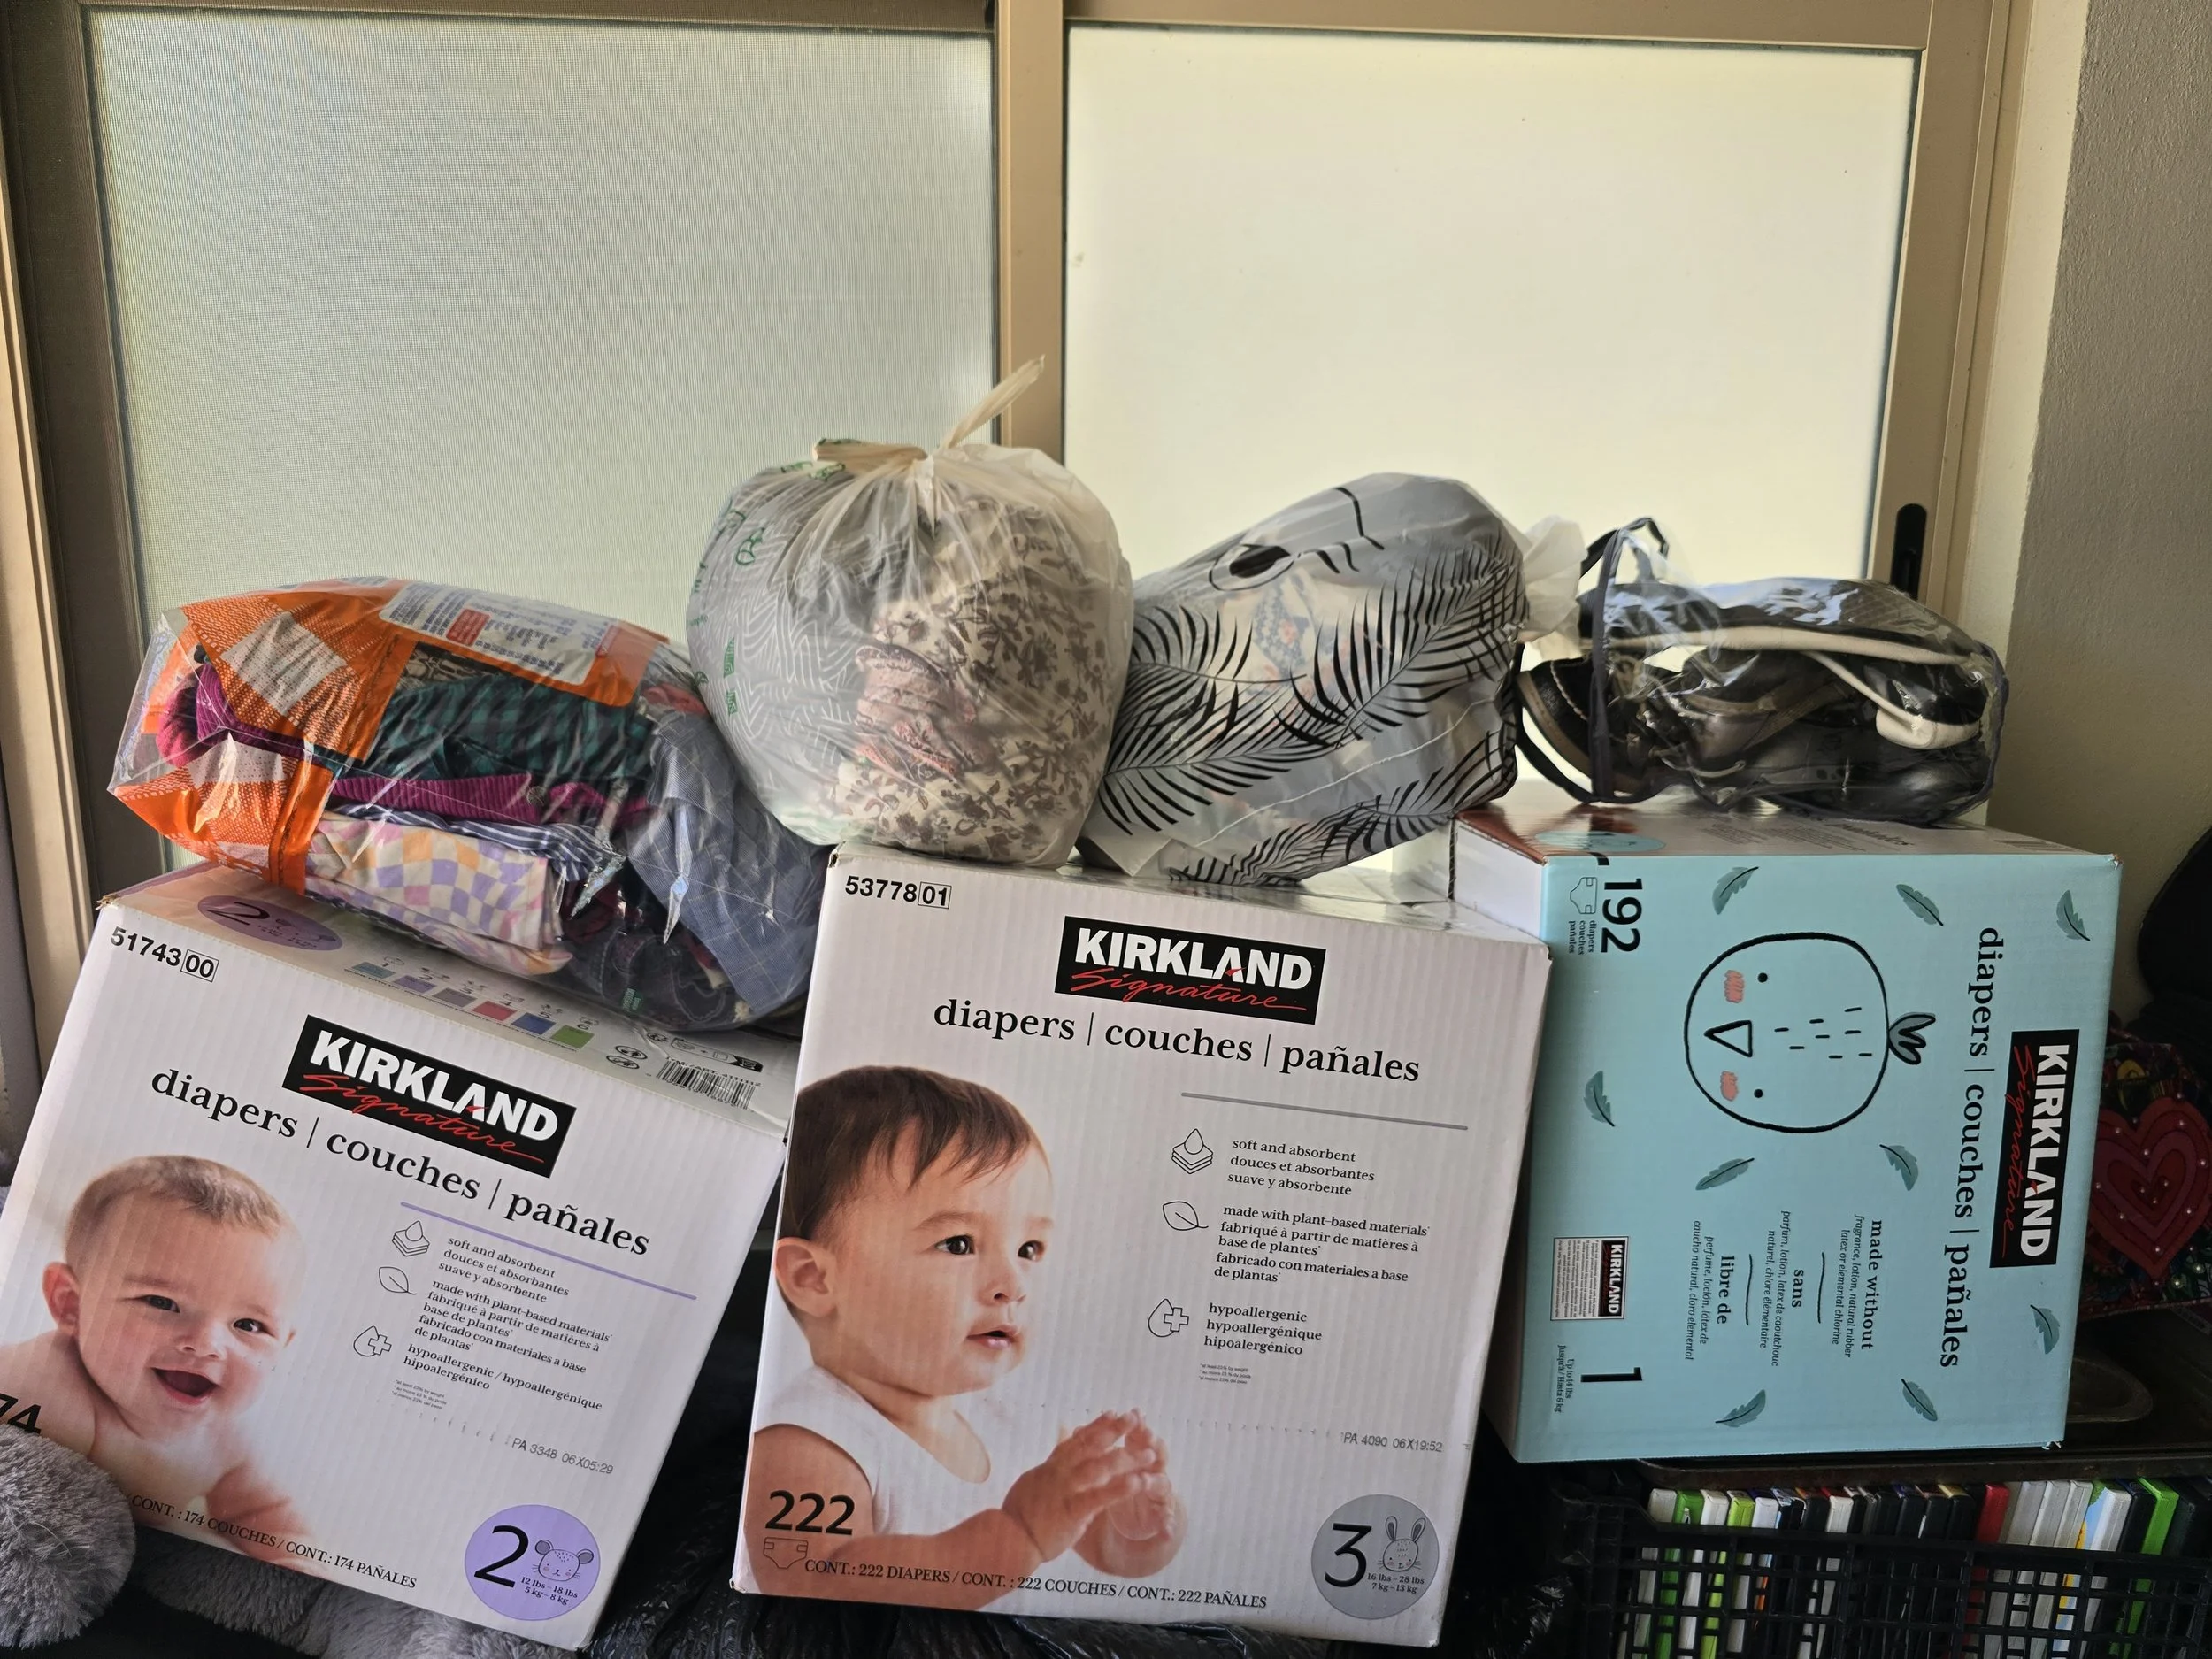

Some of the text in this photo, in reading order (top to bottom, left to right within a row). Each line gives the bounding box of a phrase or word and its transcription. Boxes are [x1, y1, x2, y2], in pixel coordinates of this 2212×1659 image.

[205, 901, 271, 926] 2
[843, 874, 949, 908] 53778 01
[1568, 920, 1577, 954] pañales
[1578, 919, 1587, 956] couches
[1586, 919, 1598, 954] diapers
[1600, 877, 1643, 953] 192
[109, 925, 215, 979] 51743 00
[1074, 927, 1313, 991] KIRKLAND
[1070, 967, 1308, 1012] Signature
[933, 998, 1419, 1082] diapers couches pañales
[309, 1029, 559, 1141] KIRKLAND
[299, 1074, 545, 1164] Signature
[151, 1068, 649, 1255] diapers couches pañales
[1229, 1155, 1374, 1181] douces et absorbantes
[1232, 1139, 1356, 1163] soft and absorbent
[1939, 927, 2004, 1367] diapers couches pañales
[2001, 1044, 2038, 1259] Signature
[2019, 1044, 2070, 1258] KIRKLAND
[1226, 1173, 1352, 1195] suave y absorbente
[1219, 1220, 1418, 1252] fabriqué à partir de matières à
[1222, 1206, 1259, 1218] made
[1260, 1209, 1290, 1222] with
[1291, 1212, 1367, 1230] plant-based
[447, 1238, 555, 1278] soft and absorbent
[1217, 1234, 1248, 1248] base
[1249, 1238, 1267, 1250] de
[438, 1262, 547, 1302] suave y absorbente
[442, 1248, 569, 1296] douces et absorbantes
[1213, 1265, 1230, 1278] de
[1216, 1251, 1409, 1282] fabricado con materiales a base
[1608, 1243, 1624, 1315] KIRKLAND
[1684, 1219, 1701, 1360] caucho natural, cloro elemental
[1698, 1235, 1715, 1345] perfume, loción, látex de
[1716, 1255, 1735, 1324] libre de
[1758, 1230, 1776, 1348] naturel, chlore élémentaire
[1770, 1210, 1791, 1366] parfum, lotion, latex de caoutchouc
[1790, 1269, 1804, 1308] sans
[1831, 1228, 1851, 1345] latex or elemental chlorine
[1843, 1213, 1865, 1358] fragrance, lotion, natural rubber
[1860, 1219, 1883, 1349] made without
[422, 1302, 449, 1317] base
[450, 1311, 465, 1323] de
[426, 1290, 478, 1314] fabriqué
[479, 1307, 487, 1317] à
[487, 1311, 524, 1328] partir
[524, 1322, 540, 1333] de
[540, 1328, 590, 1349] matières
[431, 1280, 464, 1296] made
[465, 1290, 490, 1305] with
[490, 1300, 557, 1326] plant-based
[1208, 1302, 1307, 1322] hypoallergenic
[413, 1326, 428, 1337] de
[418, 1314, 472, 1338] fabricado
[472, 1333, 493, 1345] con
[494, 1340, 551, 1363] materiales
[561, 1358, 587, 1373] base
[1203, 1334, 1303, 1356] hipoalergénico
[1205, 1318, 1322, 1341] hypoallergénique
[403, 1355, 490, 1389] hipoalergénico
[407, 1342, 603, 1410] hypoallergenic hypoallergénique
[764, 1489, 855, 1536] 222
[131, 1494, 419, 1589] CONT. 174 COUCHES CONT.: 174 PAÑALES
[473, 1525, 530, 1588] 2
[1325, 1523, 1372, 1587] 3
[520, 1576, 579, 1599] 12 lbs 18 lbs
[803, 1559, 1268, 1609] CONT.: 222 DIAPERS CONT. 222 COUCHES CONT.: 222 PAÑALES
[1366, 1571, 1425, 1585] 16 lbs 28 lbs
